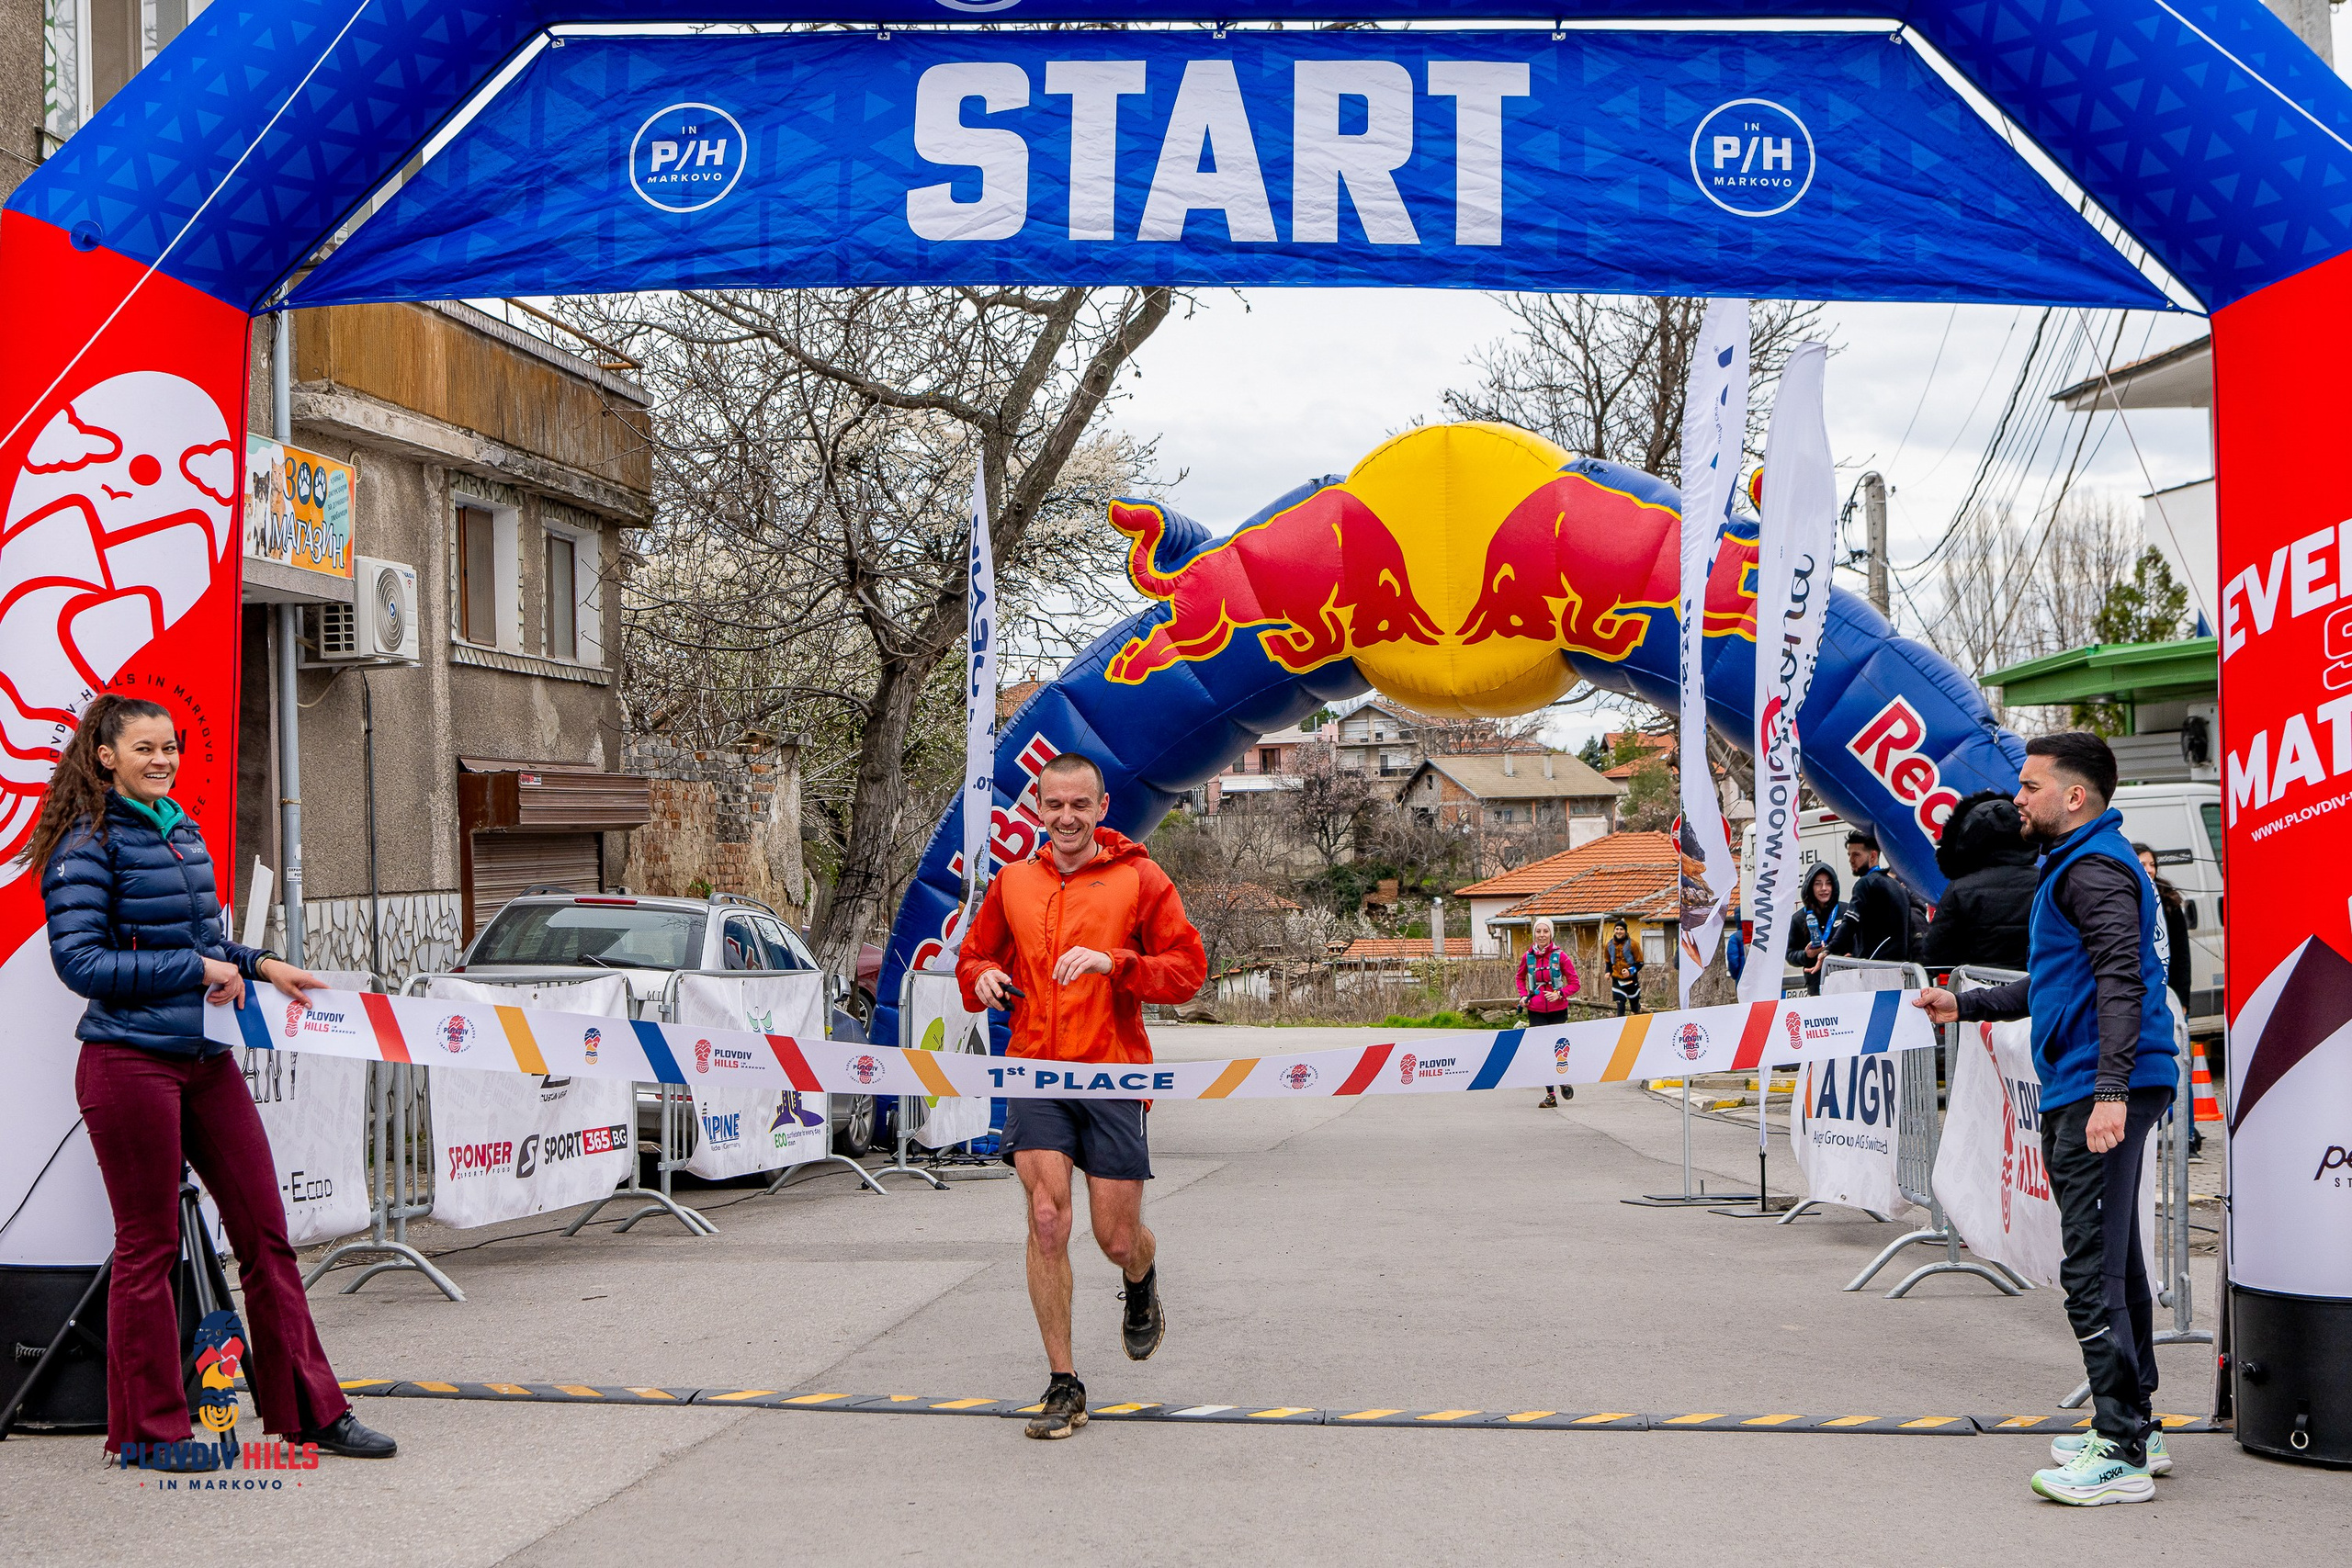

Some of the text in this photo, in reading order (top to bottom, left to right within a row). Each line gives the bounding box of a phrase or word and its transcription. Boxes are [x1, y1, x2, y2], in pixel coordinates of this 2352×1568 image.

[682, 126, 697, 135] IN
[1744, 122, 1760, 131] IN
[650, 139, 728, 173] P/H
[906, 59, 1530, 246] START
[1713, 136, 1792, 174] P/H
[647, 173, 722, 184] MARKOVO
[1713, 176, 1792, 187] MARKOVO
[271, 512, 345, 570] МАГАЗИН
[2222, 518, 2352, 663] EVE
[80, 673, 136, 702] HILLS
[148, 674, 165, 687] IN
[174, 684, 213, 762] MARKOVO
[2251, 789, 2352, 842] WWW.PLOVDIV-
[306, 1010, 345, 1023] PLOVDIV
[1804, 1016, 1838, 1029] PLOVDIV
[304, 1021, 329, 1032] HILLS
[1805, 1028, 1829, 1039] HILLS
[715, 1049, 752, 1060] PLOVDIV
[714, 1058, 739, 1068] HILLS
[1419, 1058, 1456, 1068] PLOVDIV
[988, 1066, 1174, 1090] 1st PLACE
[1419, 1068, 1443, 1077] HILLS
[775, 1133, 787, 1148] ECO
[448, 1141, 513, 1182] SPONSER
[2098, 1466, 2123, 1484] HOKA
